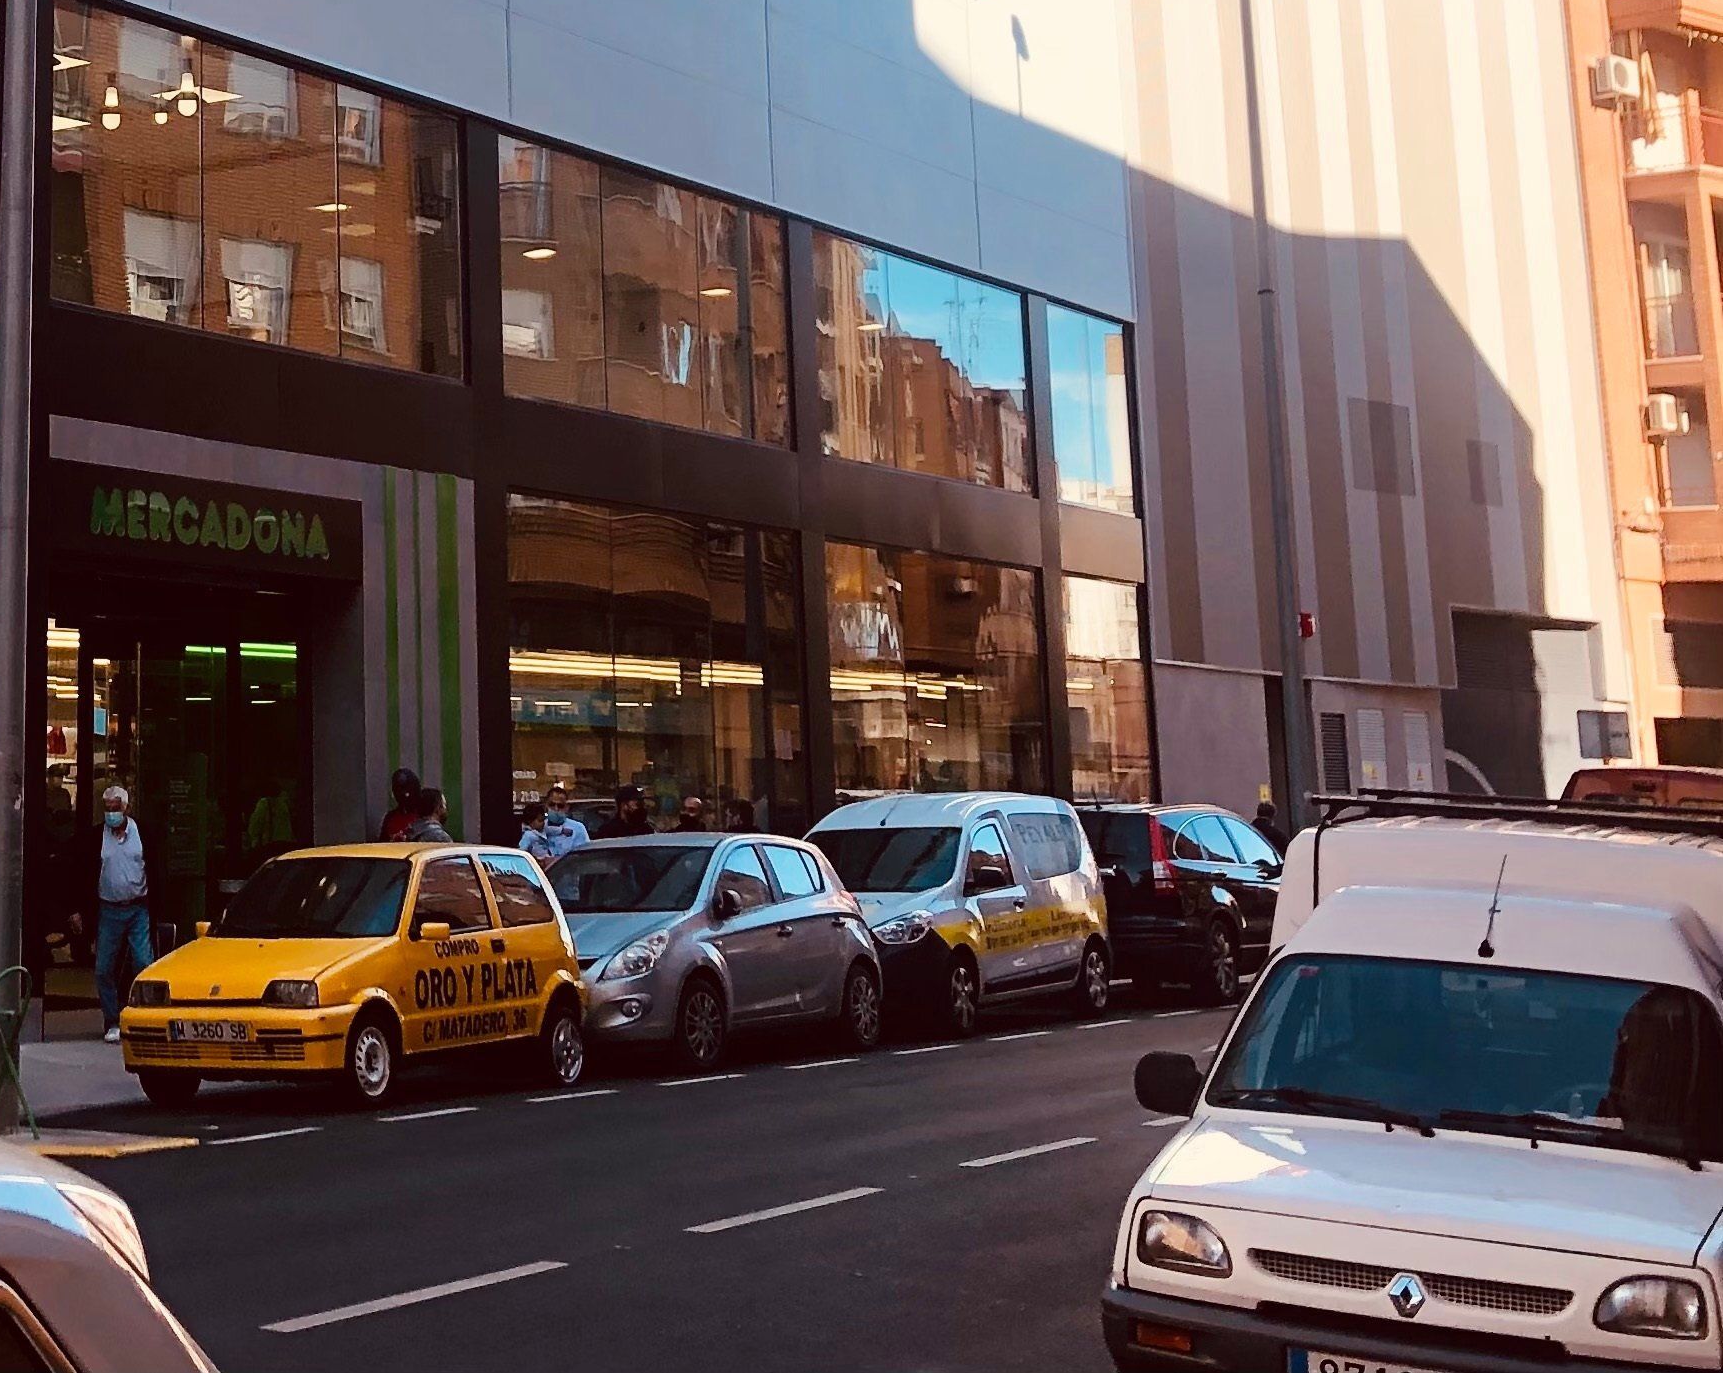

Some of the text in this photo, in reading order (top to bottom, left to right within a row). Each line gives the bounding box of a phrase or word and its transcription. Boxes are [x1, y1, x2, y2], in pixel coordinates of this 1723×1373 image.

[89, 485, 330, 560] MERCADONA
[434, 939, 479, 959] COMPRO
[414, 957, 537, 1010] ORO Y PLATA
[230, 1023, 247, 1040] SB
